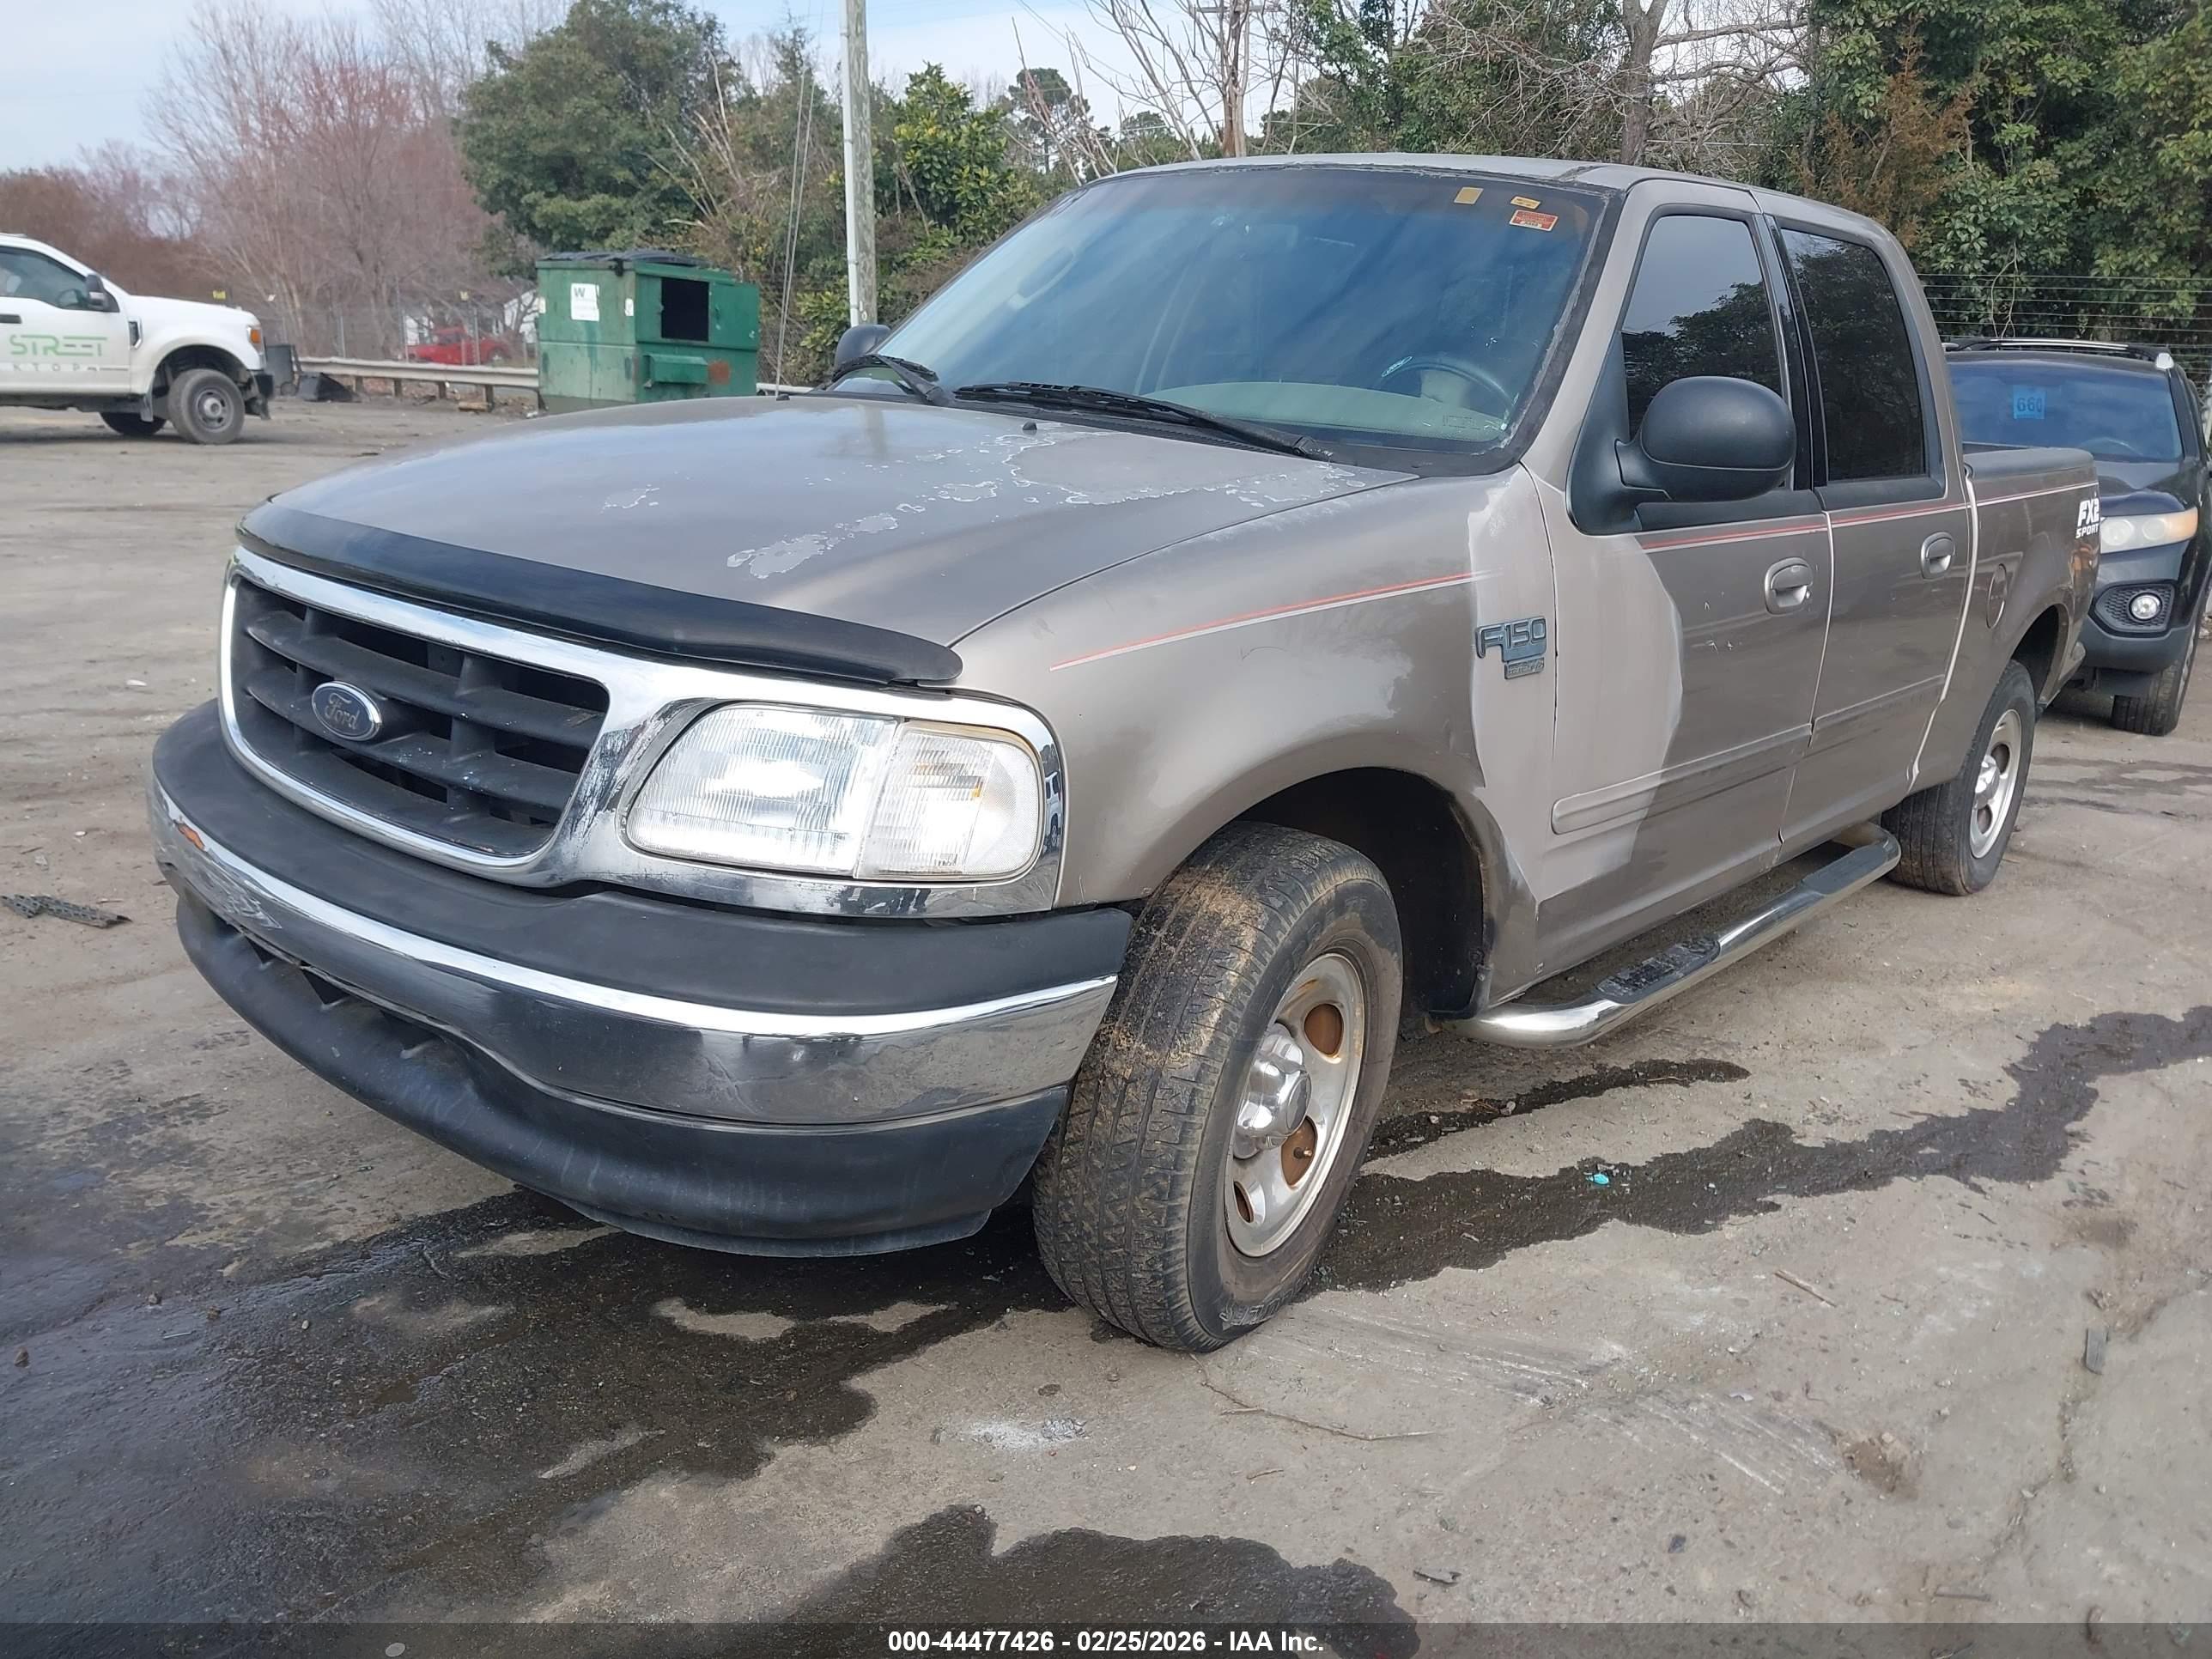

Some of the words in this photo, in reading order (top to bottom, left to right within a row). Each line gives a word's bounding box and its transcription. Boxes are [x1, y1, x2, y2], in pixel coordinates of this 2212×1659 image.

[9, 334, 108, 357] STREET
[2075, 523, 2100, 539] SPORT
[323, 691, 362, 731] Ford
